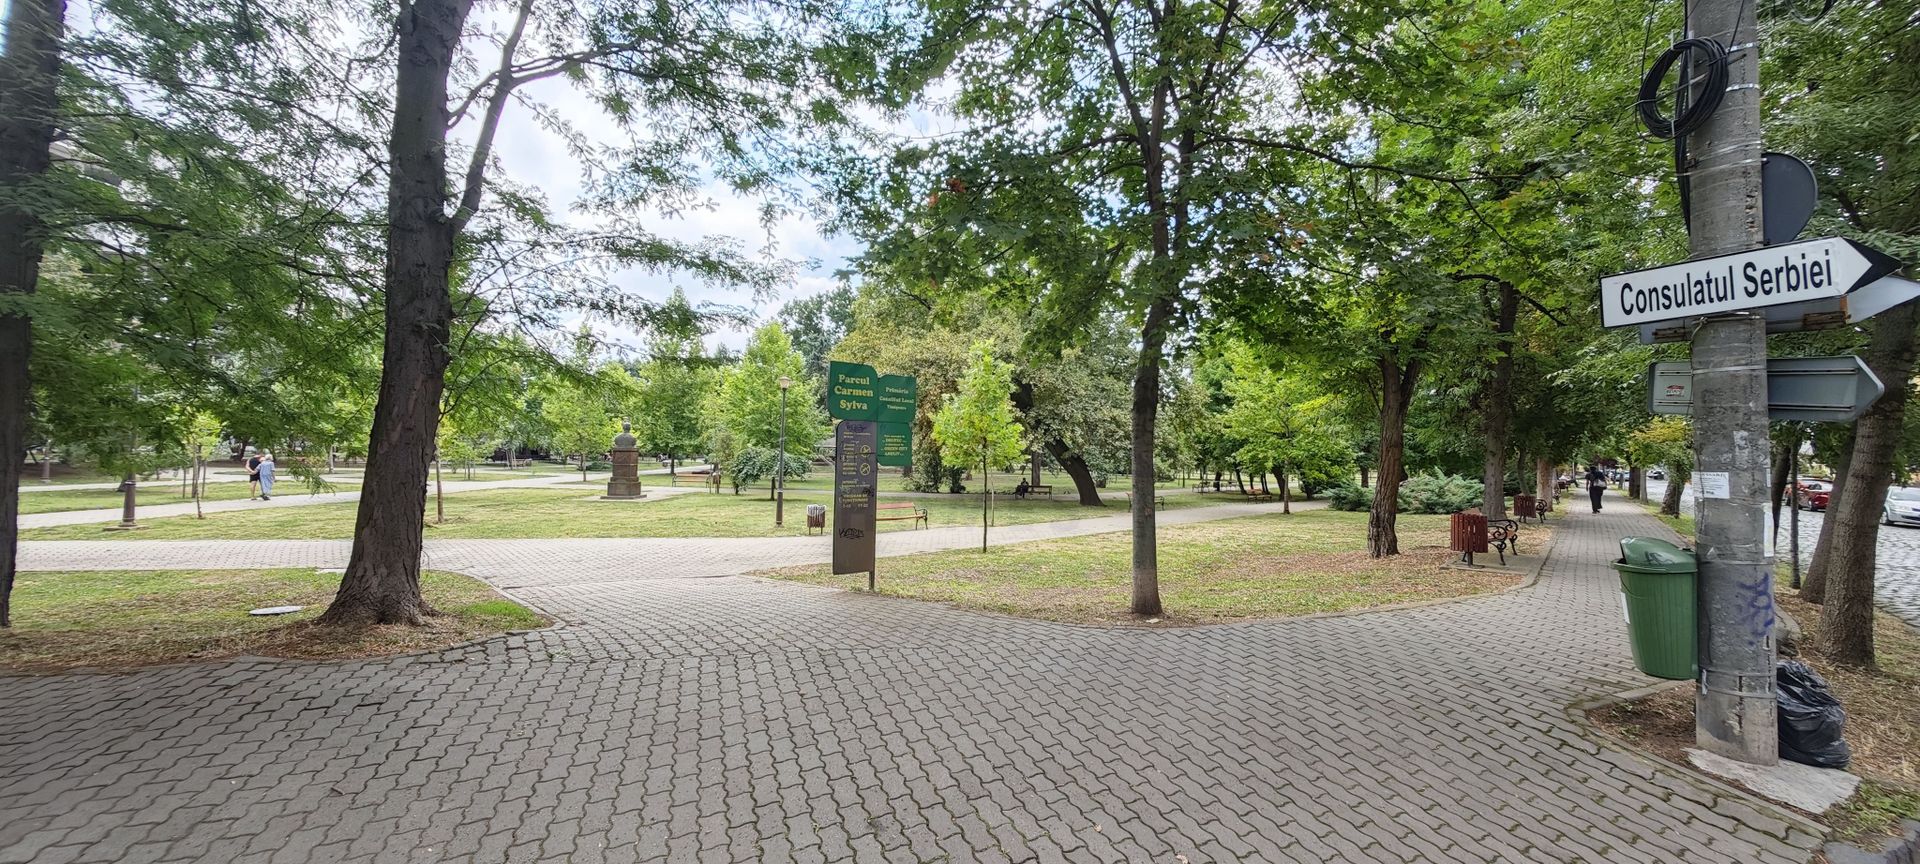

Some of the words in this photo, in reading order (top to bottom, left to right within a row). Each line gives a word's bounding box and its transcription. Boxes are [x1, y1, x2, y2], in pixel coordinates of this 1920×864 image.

[1621, 266, 1735, 315] Consulatul
[1743, 249, 1832, 298] Serbiei
[838, 374, 870, 385] Parcul
[834, 385, 874, 397] Carmen
[839, 399, 868, 411] Sylva
